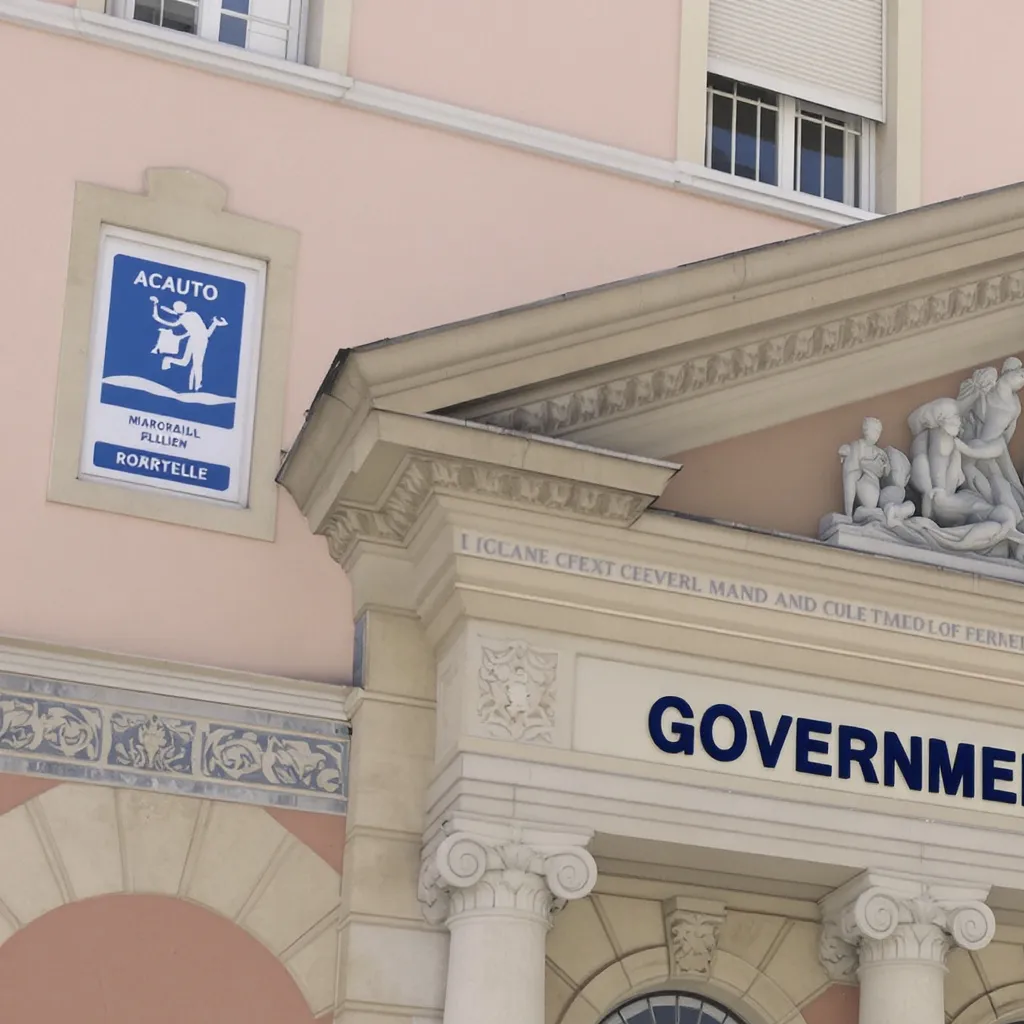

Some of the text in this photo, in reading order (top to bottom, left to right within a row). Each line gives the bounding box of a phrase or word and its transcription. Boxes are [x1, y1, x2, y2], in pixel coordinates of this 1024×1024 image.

[133, 270, 219, 301] ACAUTO
[709, 579, 768, 604] MAND
[774, 592, 817, 613] AND
